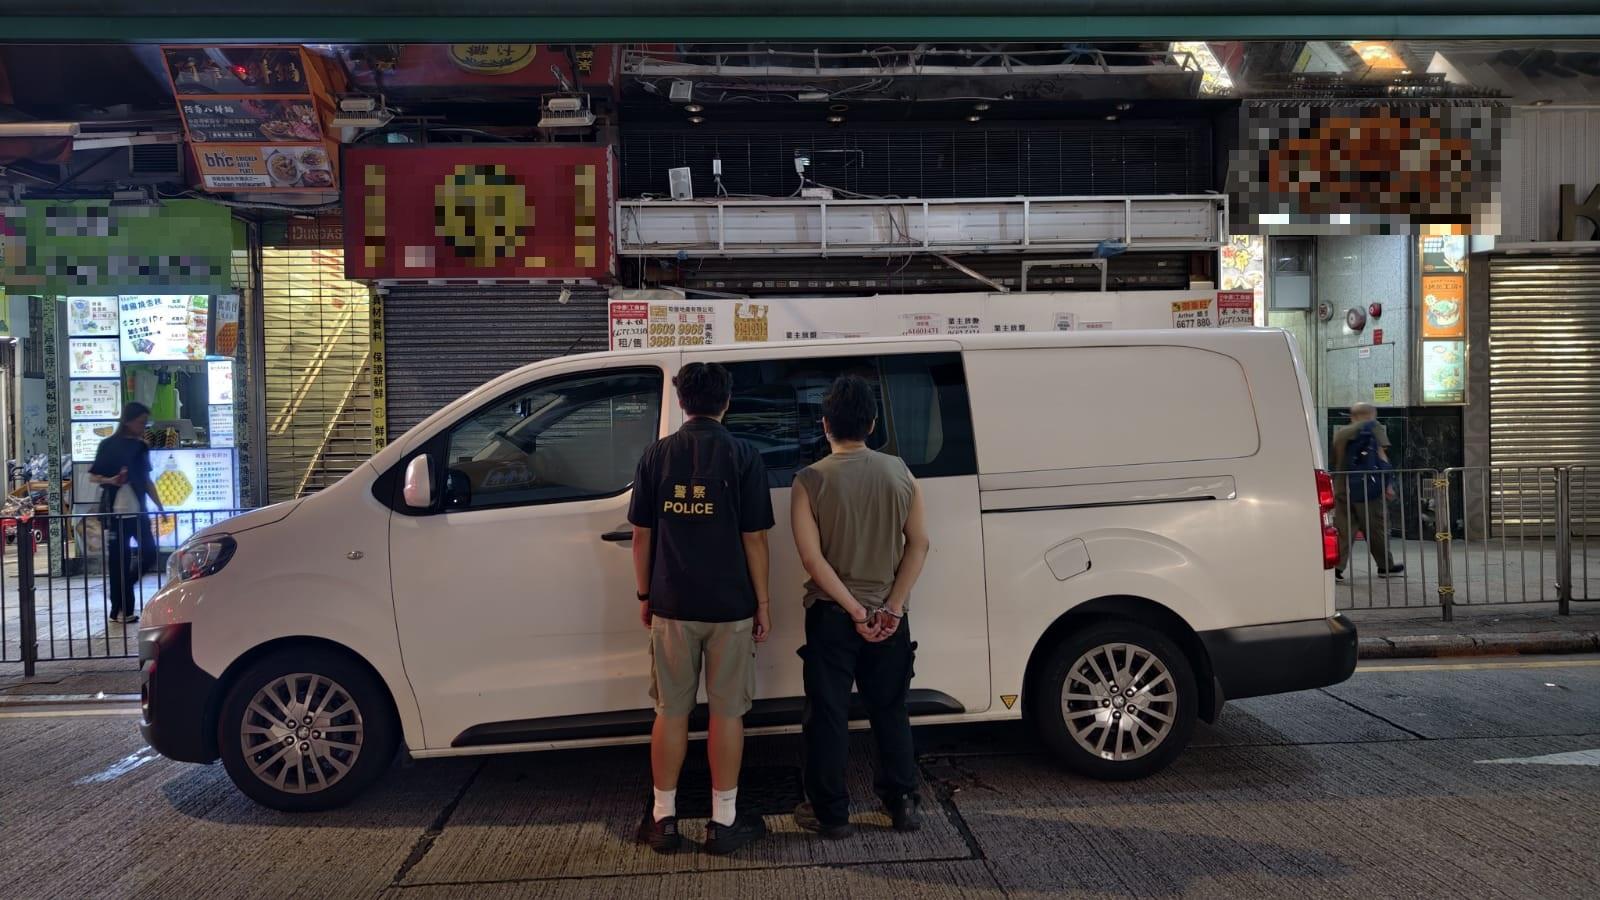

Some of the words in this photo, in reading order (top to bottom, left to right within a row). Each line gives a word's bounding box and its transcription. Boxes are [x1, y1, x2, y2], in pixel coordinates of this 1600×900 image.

[205, 152, 234, 167] bhc
[373, 352, 383, 399] 保證新鮮
[674, 485, 706, 498] 警察
[664, 502, 714, 514] POLICE
